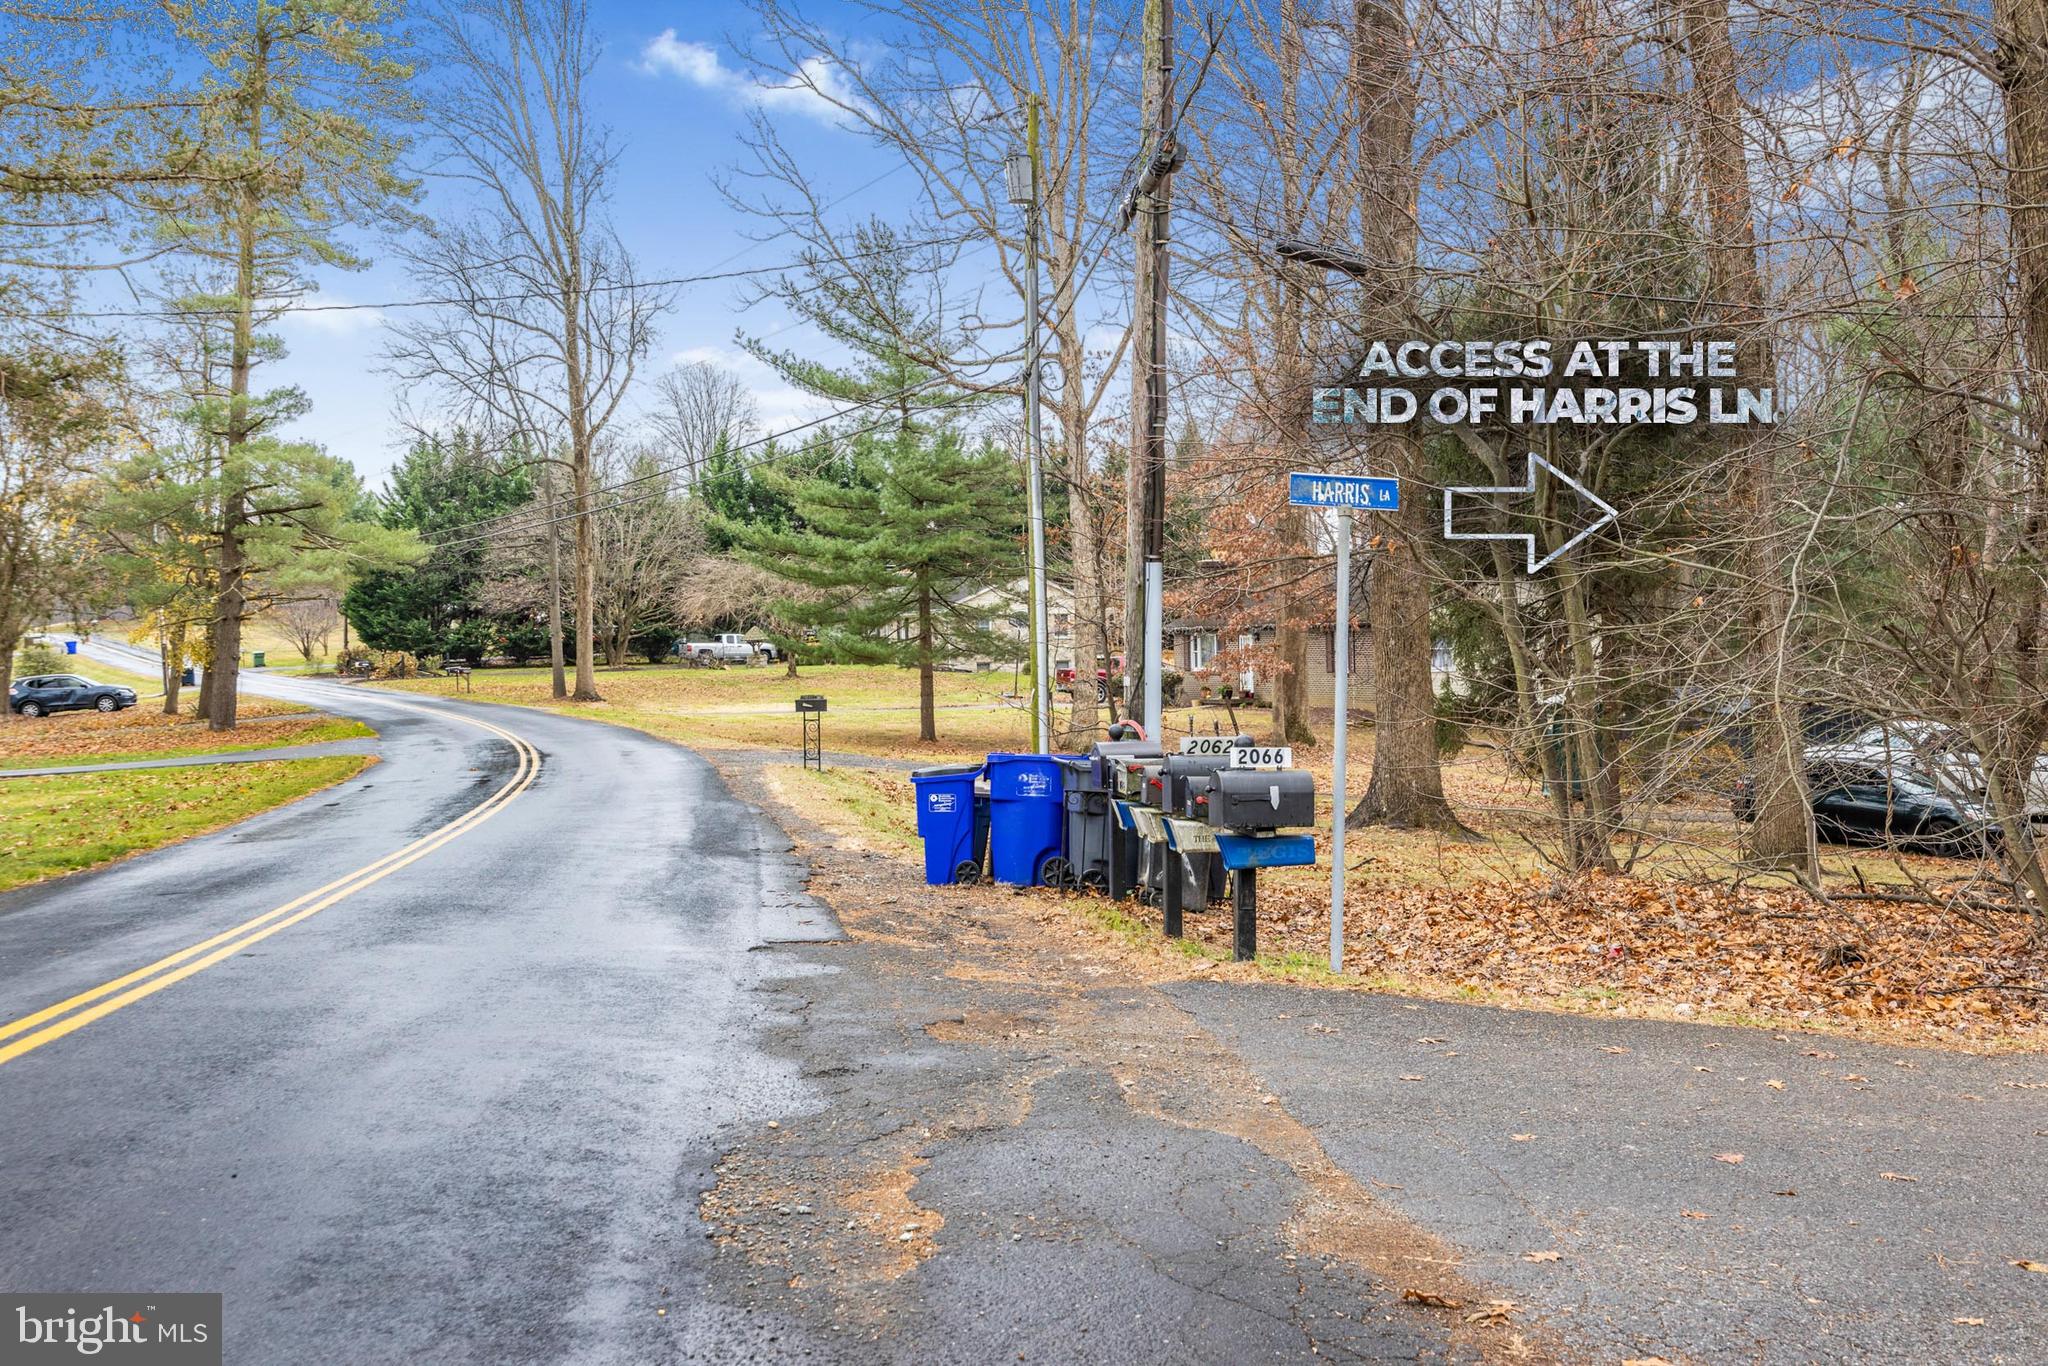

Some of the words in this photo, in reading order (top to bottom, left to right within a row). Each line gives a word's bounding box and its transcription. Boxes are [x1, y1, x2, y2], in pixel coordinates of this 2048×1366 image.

[1312, 480, 1371, 505] HARRIS
[1379, 488, 1391, 502] LA
[1187, 739, 1234, 755] 2062
[1238, 748, 1284, 765] 2066
[1193, 835, 1211, 843] THE
